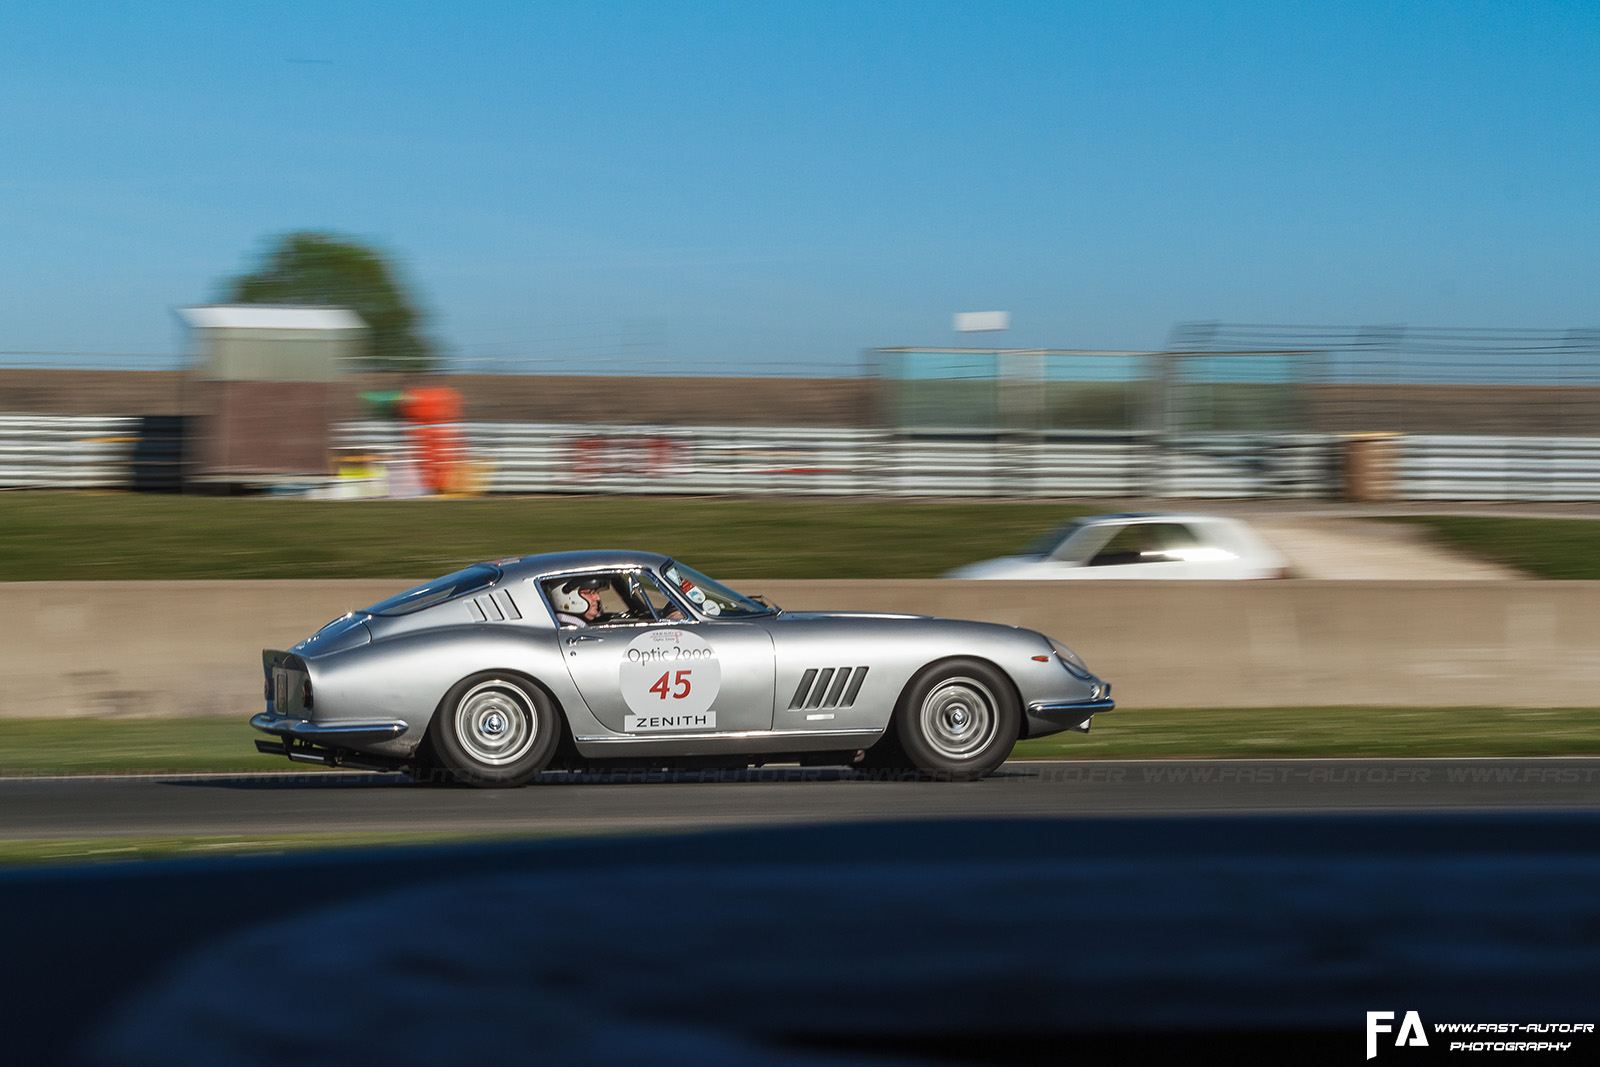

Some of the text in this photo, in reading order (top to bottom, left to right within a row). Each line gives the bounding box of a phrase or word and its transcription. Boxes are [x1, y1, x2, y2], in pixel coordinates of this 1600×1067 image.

[627, 646, 712, 666] Optic 2000
[649, 670, 692, 700] 45
[636, 715, 706, 728] ZENITH
